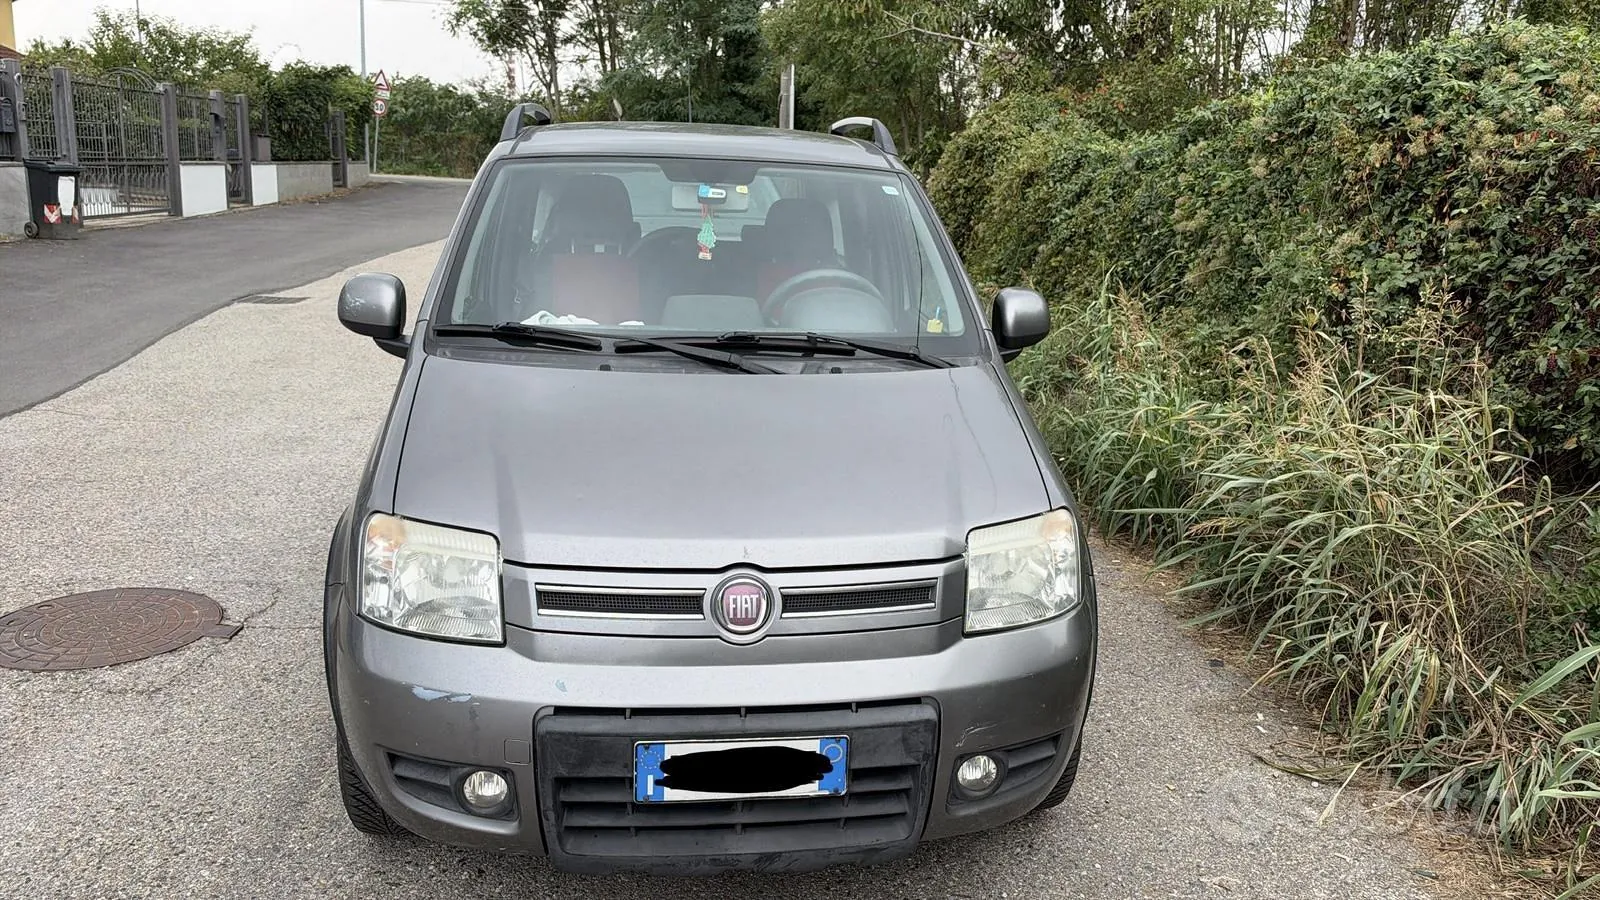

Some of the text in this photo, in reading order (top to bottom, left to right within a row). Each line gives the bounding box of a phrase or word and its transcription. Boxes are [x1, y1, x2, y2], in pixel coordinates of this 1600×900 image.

[374, 102, 384, 112] 30
[729, 594, 759, 619] FIAT
[647, 774, 654, 796] I
